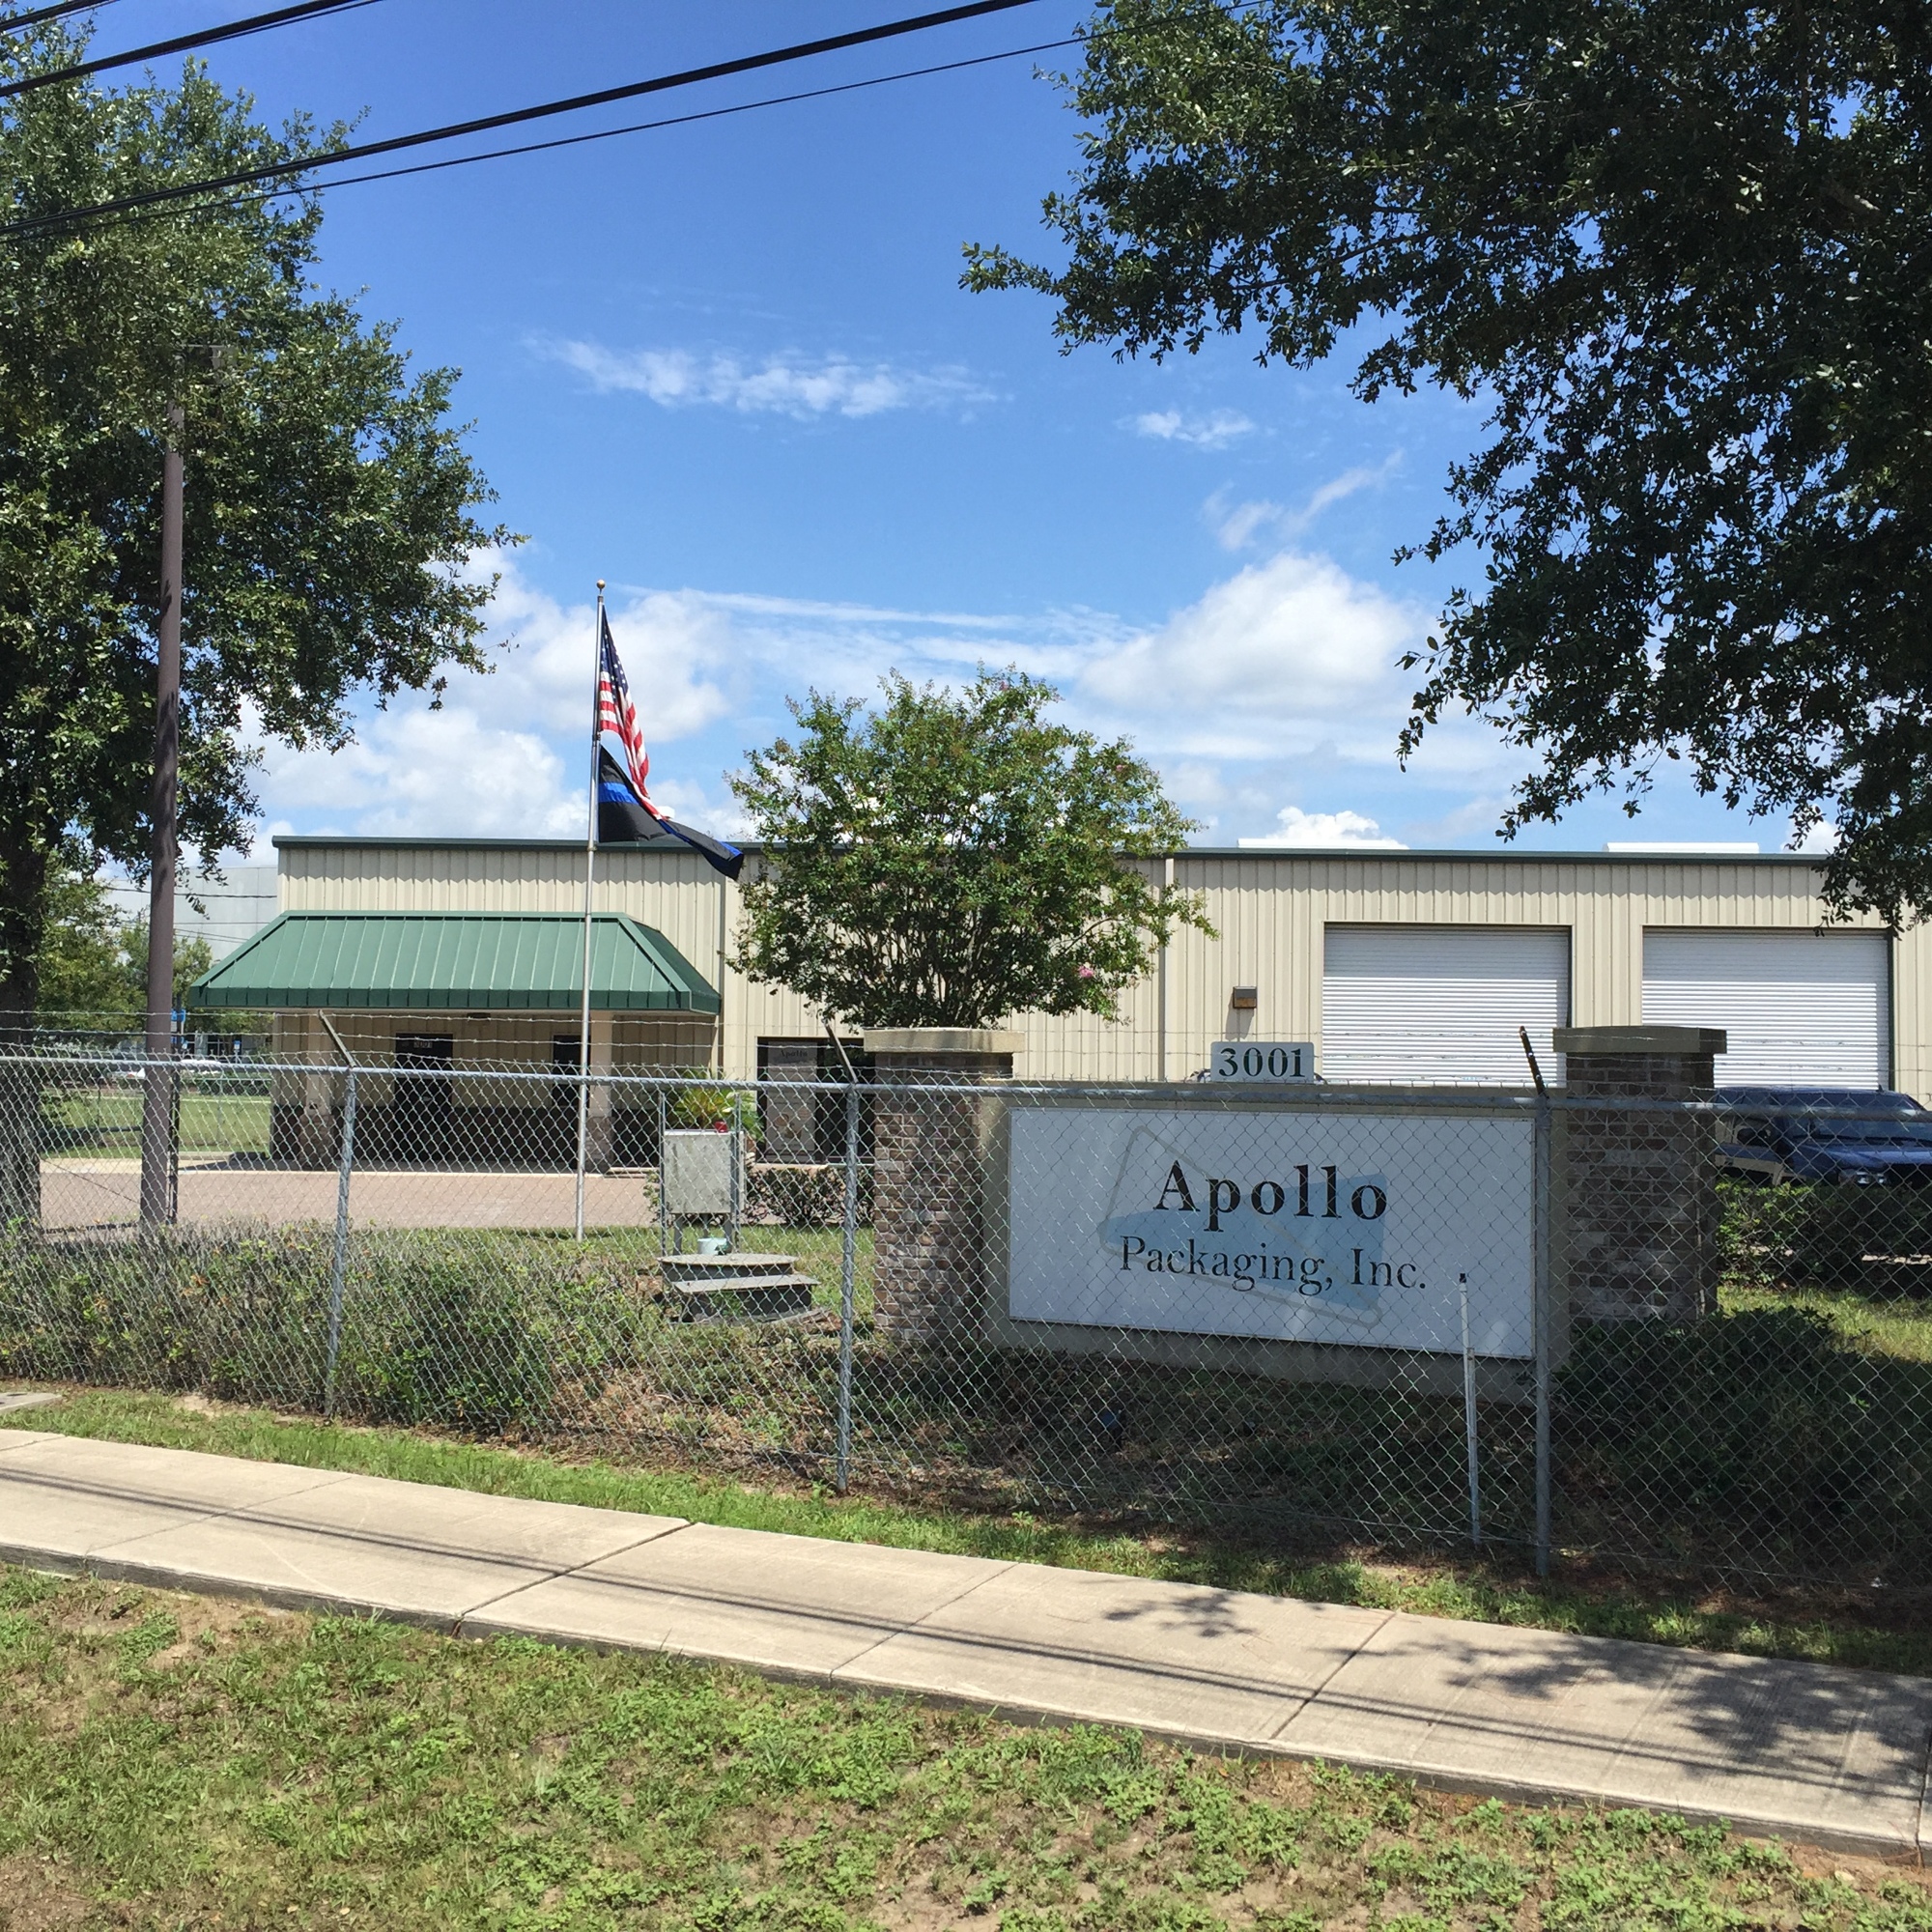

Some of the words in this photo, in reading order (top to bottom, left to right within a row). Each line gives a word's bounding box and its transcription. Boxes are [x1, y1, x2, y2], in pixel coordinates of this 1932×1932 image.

[1218, 1047, 1305, 1077] 3001
[1152, 1159, 1387, 1233] Apollo
[1120, 1236, 1333, 1295] Packaging,
[1350, 1248, 1426, 1289] Inc.
